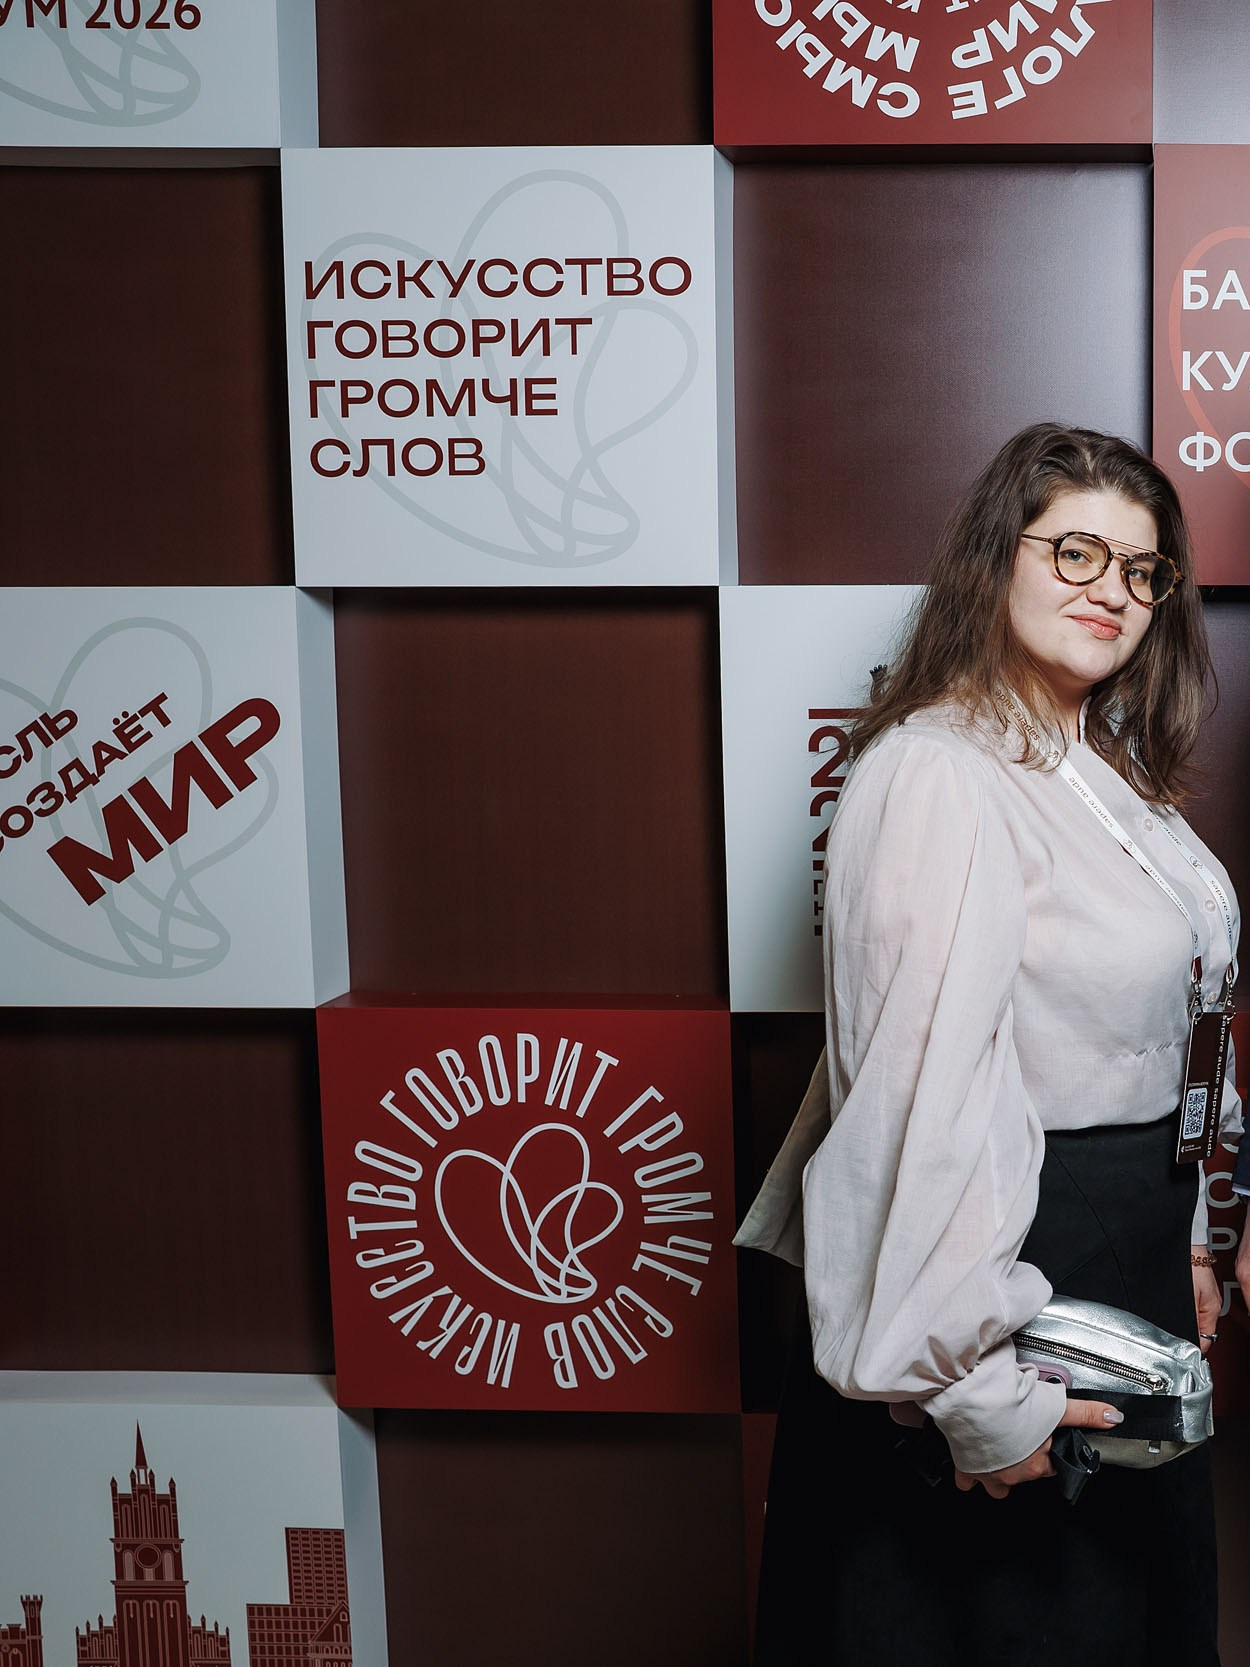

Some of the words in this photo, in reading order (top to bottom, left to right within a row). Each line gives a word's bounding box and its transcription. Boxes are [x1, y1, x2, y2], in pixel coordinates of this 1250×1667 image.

[85, 0, 201, 30] 2026
[947, 0, 1108, 119] ЛОГЕ
[952, 0, 1057, 69] ИР
[303, 256, 692, 300] ИСКУССТВО
[306, 318, 592, 359] ГОВОРИТ
[308, 378, 558, 418] ГРОМЧЕ
[310, 438, 486, 477] СЛОВ
[0, 692, 172, 852] ОЗДАЁТ
[47, 698, 281, 906] МИР
[379, 1033, 619, 1148] ГОВОРИТ
[603, 1085, 714, 1297] ГРОМЧЕ
[347, 1140, 520, 1388] ИСКУССТВО
[544, 1285, 674, 1389] СЛОВ
